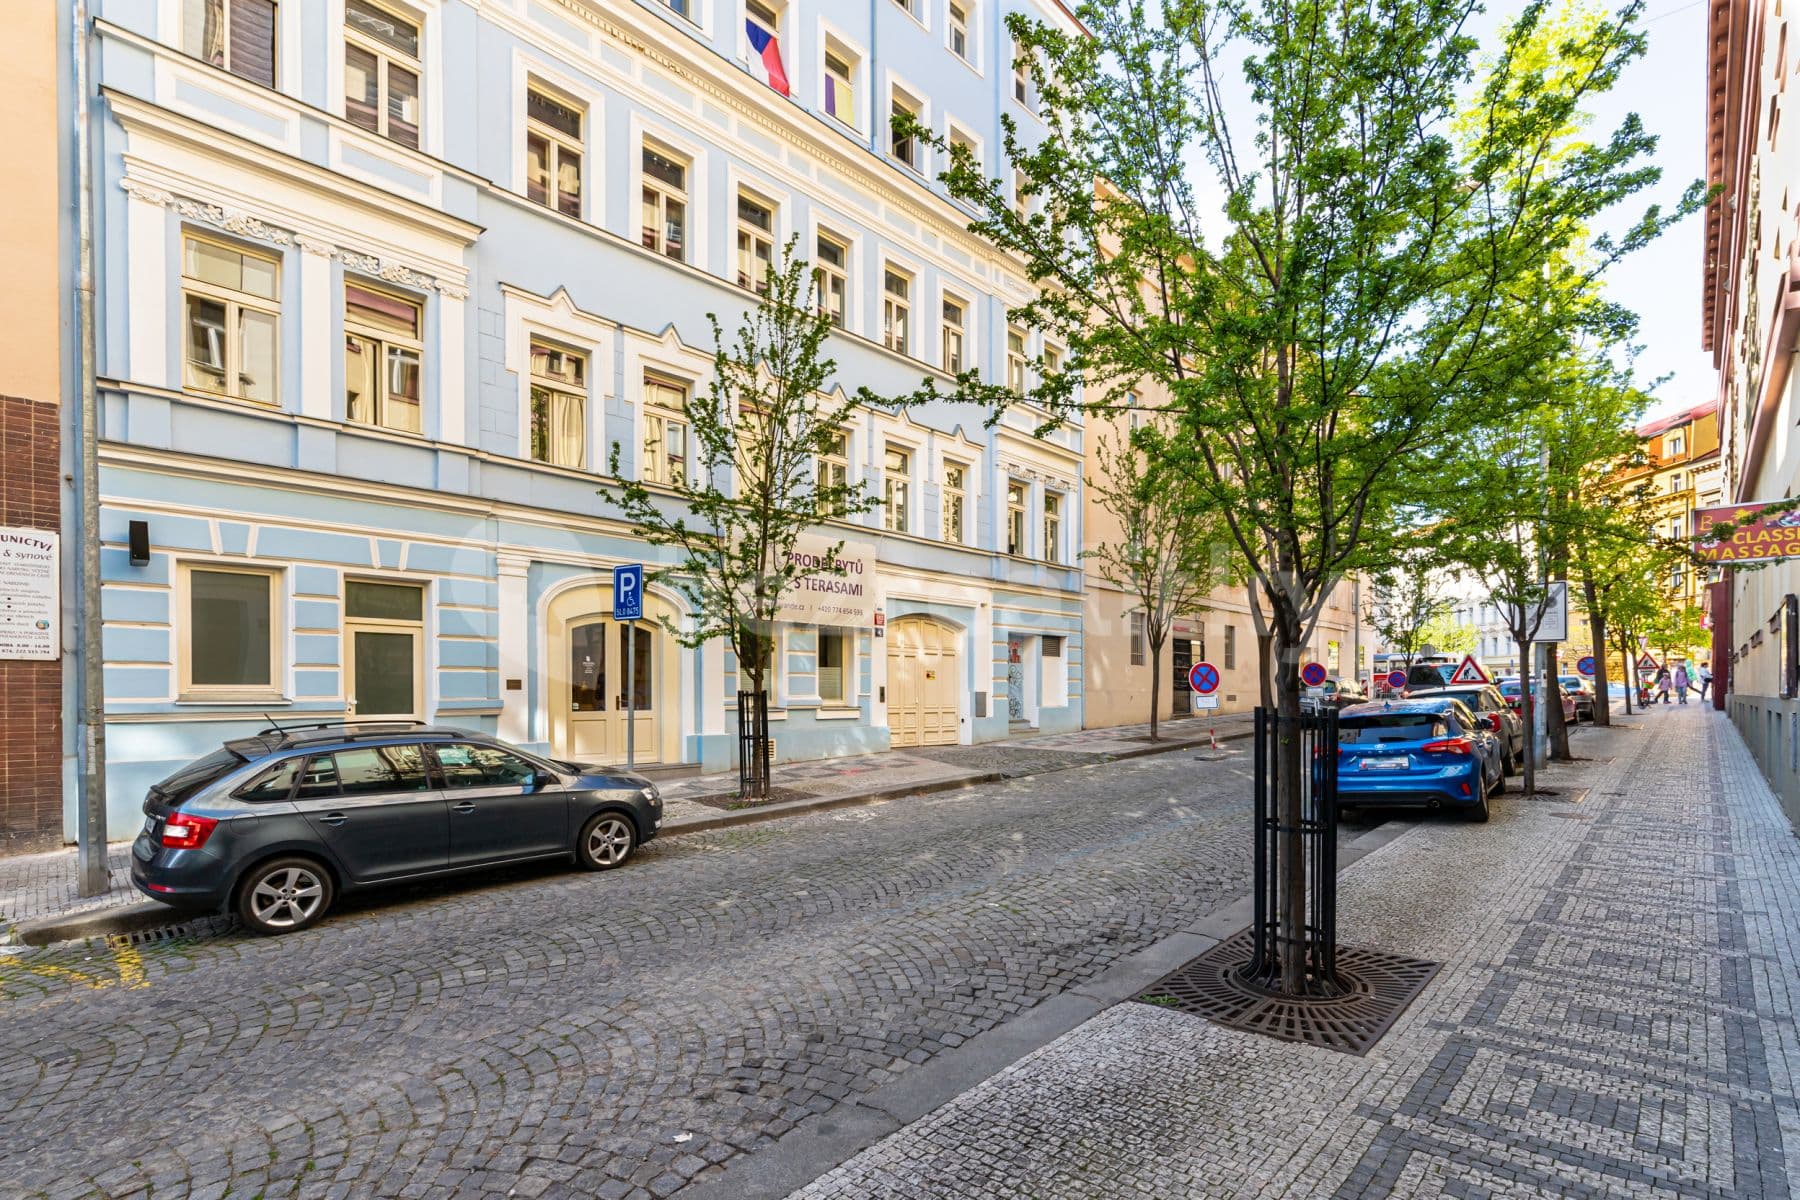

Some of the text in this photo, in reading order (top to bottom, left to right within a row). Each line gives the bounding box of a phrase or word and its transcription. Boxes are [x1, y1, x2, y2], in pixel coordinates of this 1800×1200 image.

[620, 572, 636, 603] P
[794, 576, 863, 596] S TERASAMI
